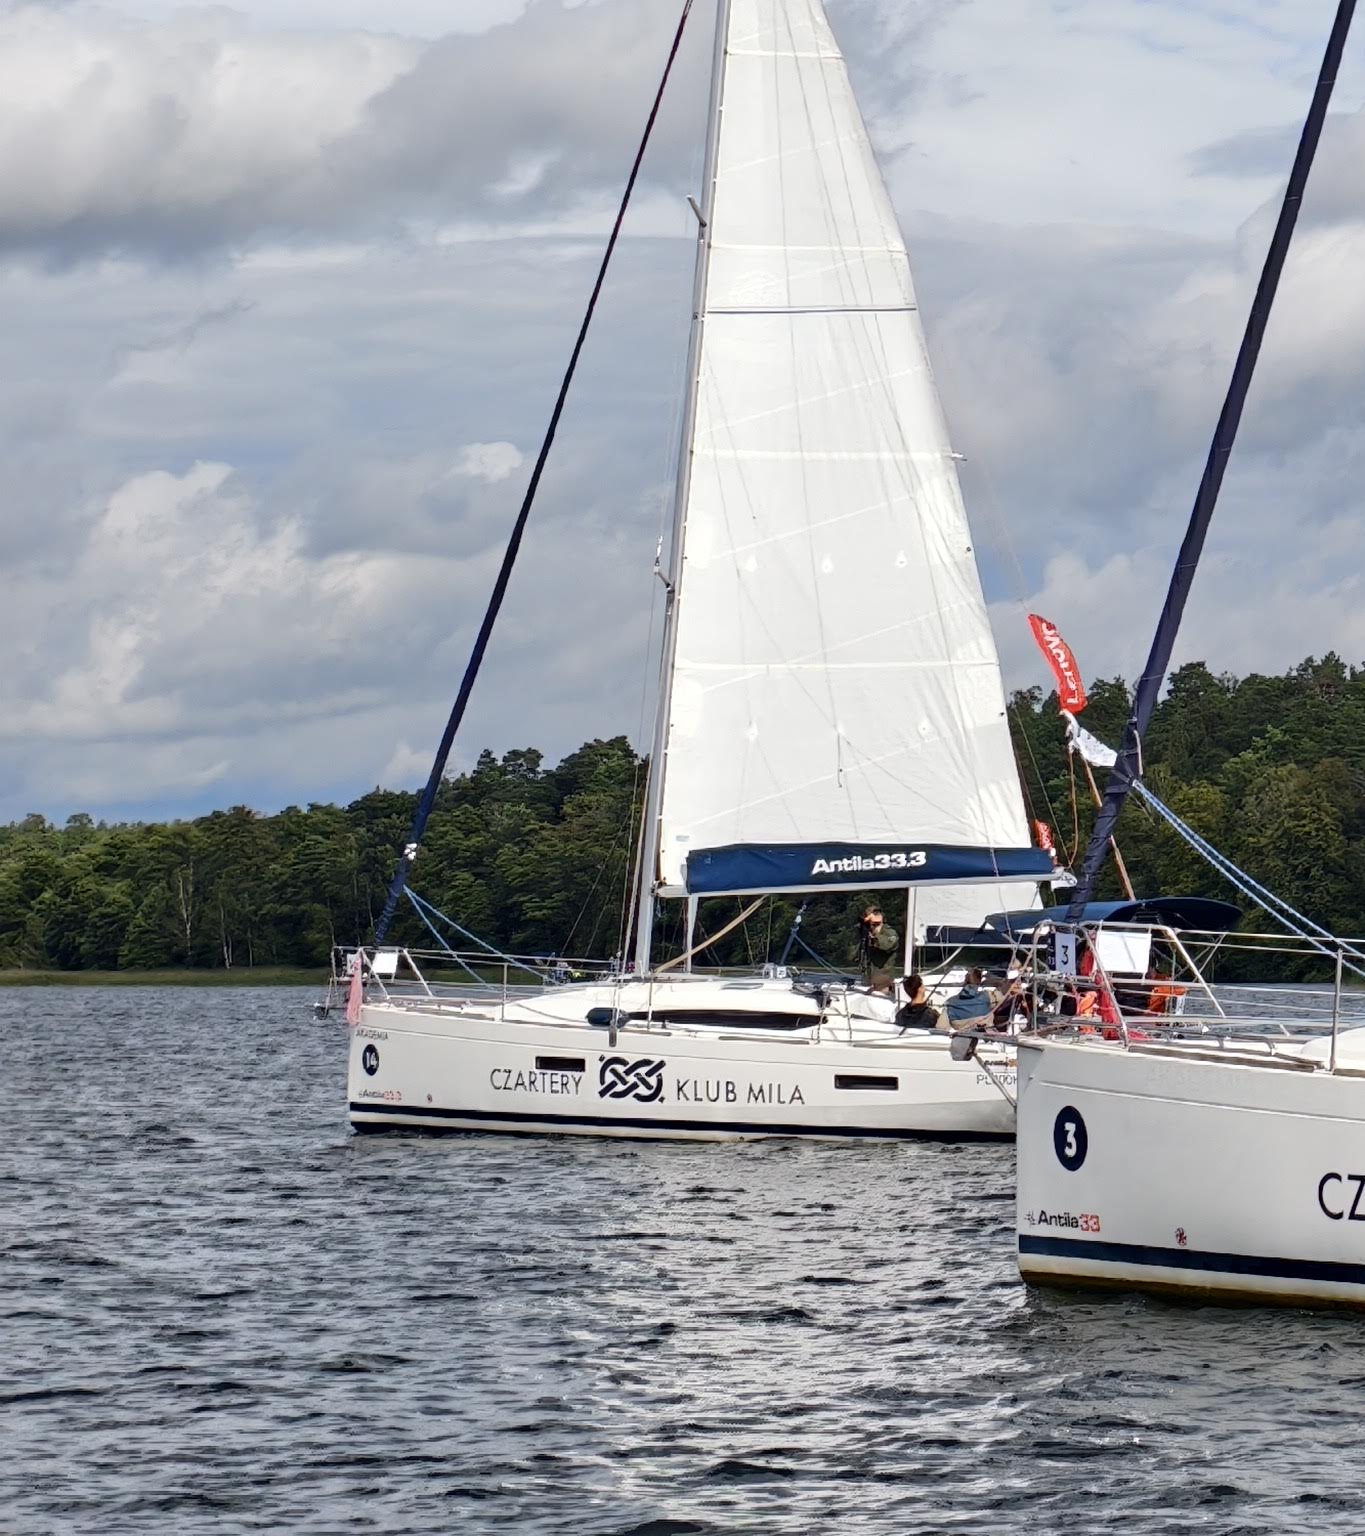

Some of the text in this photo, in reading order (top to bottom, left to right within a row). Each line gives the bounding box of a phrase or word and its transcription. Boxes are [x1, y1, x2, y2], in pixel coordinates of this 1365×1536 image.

[1061, 945, 1069, 965] 3
[490, 1068, 806, 1105] CZARTERY KLUB MILA
[1064, 1122, 1077, 1158] 3
